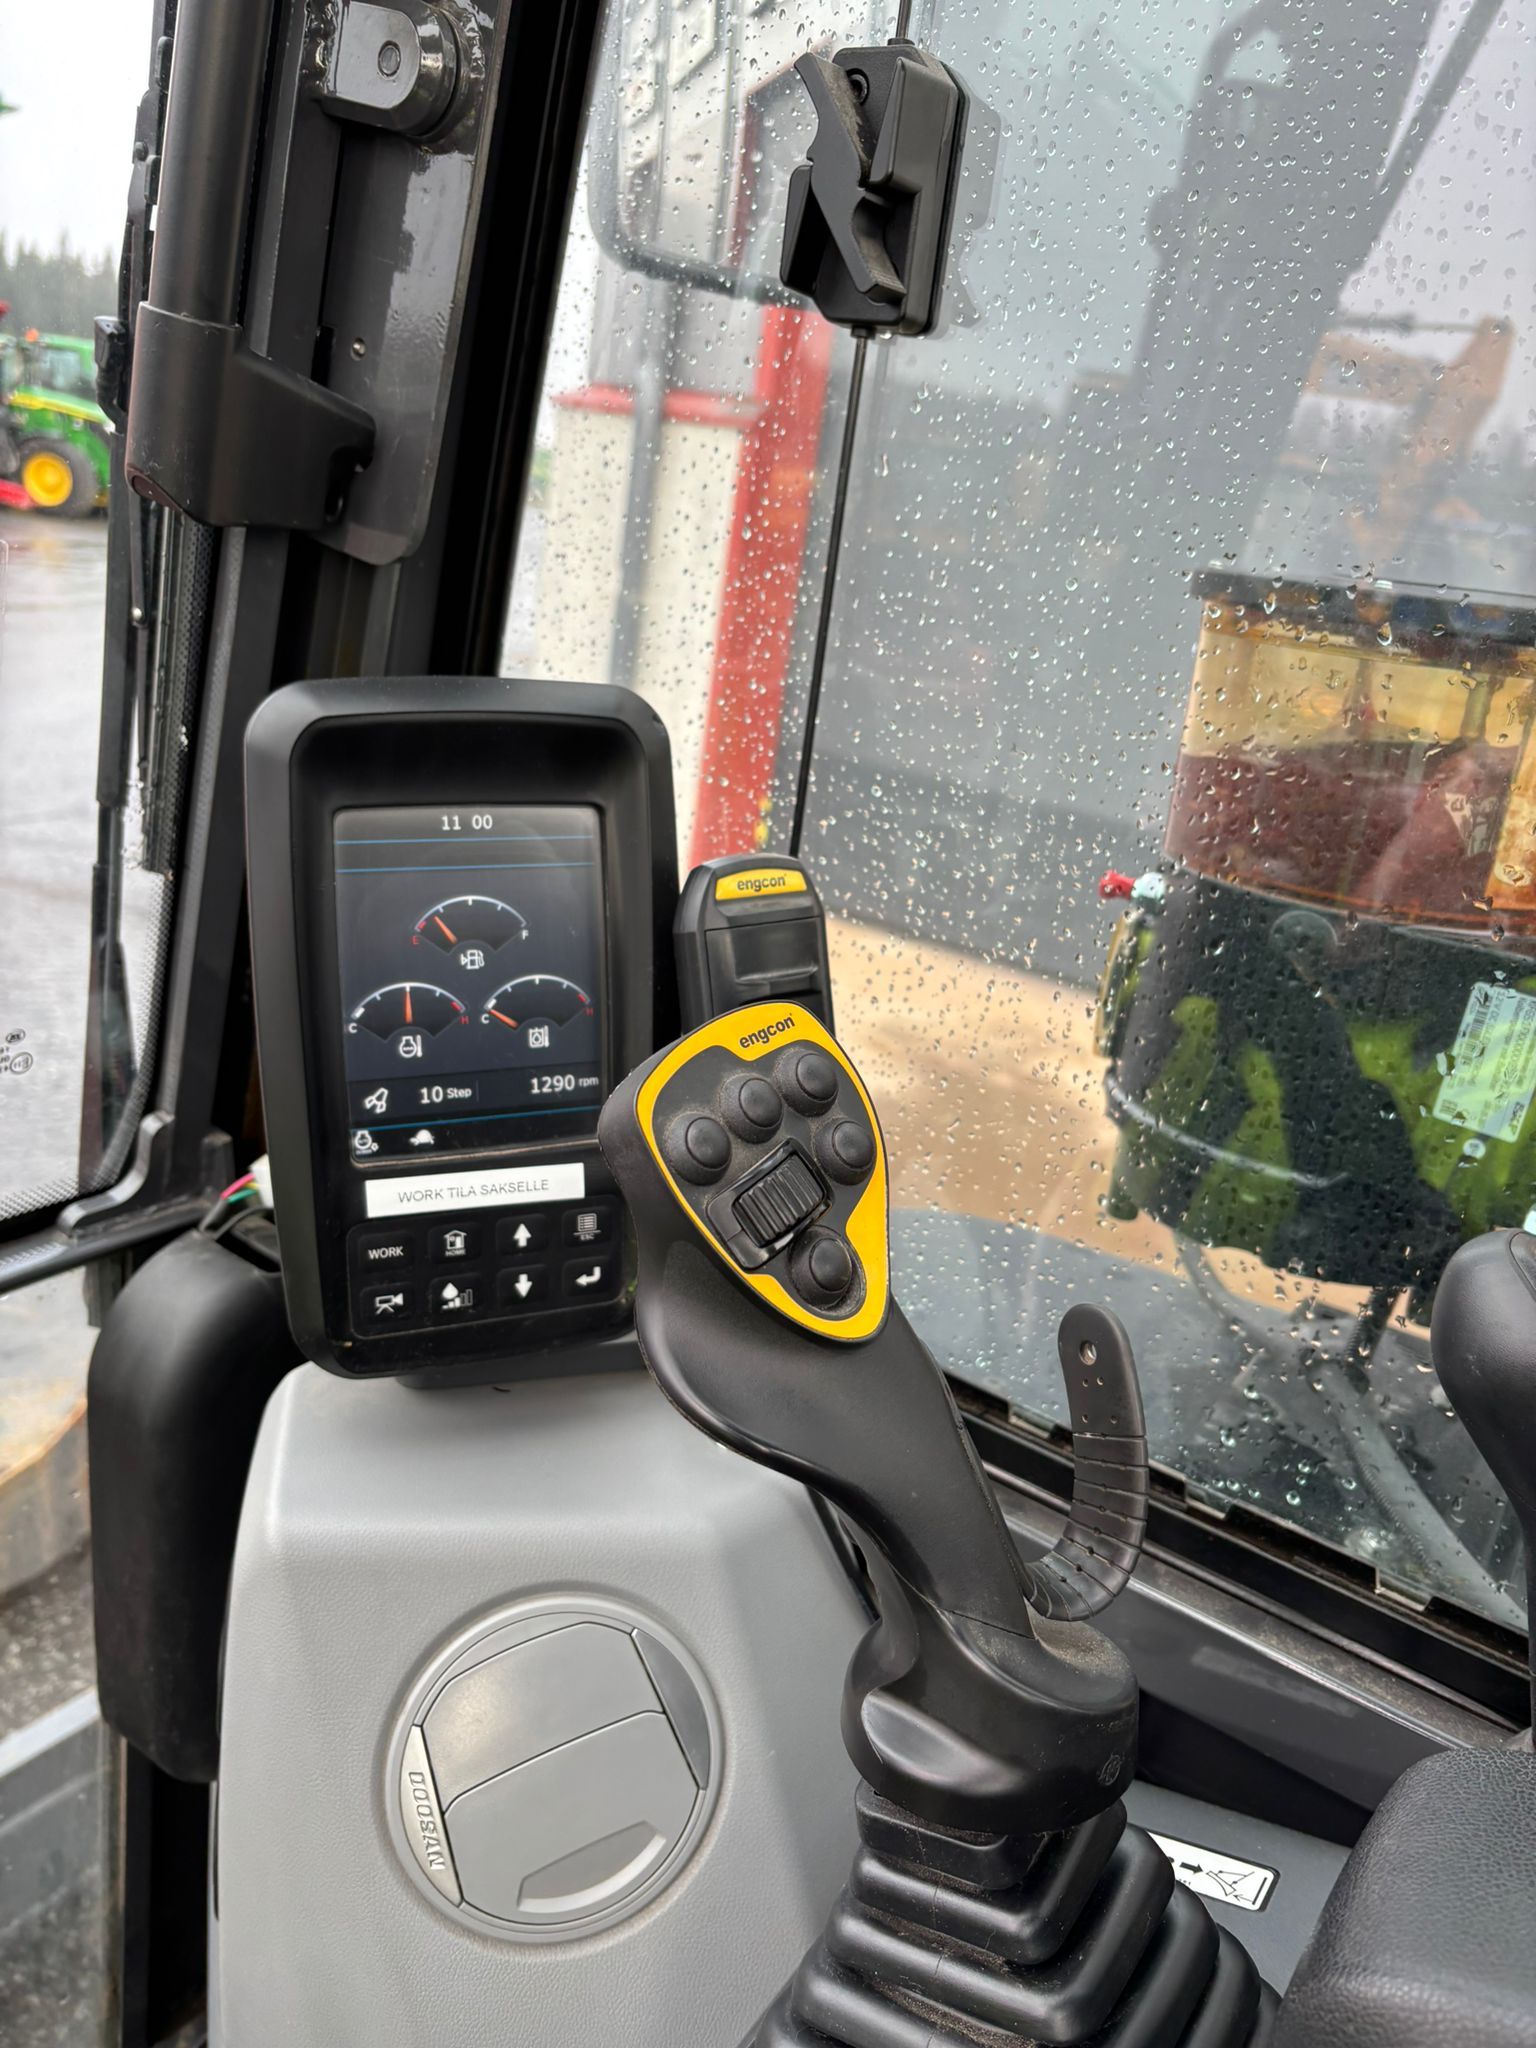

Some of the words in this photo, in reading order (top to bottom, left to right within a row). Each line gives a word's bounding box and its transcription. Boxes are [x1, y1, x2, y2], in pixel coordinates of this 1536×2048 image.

[440, 816, 462, 831] 11
[471, 815, 493, 830] 00
[737, 876, 786, 892] engcon
[411, 935, 420, 945] E
[521, 929, 529, 940] F
[480, 1013, 490, 1024] C
[585, 1006, 594, 1016] H
[460, 1015, 469, 1025] H
[348, 1023, 357, 1033] C
[739, 1017, 795, 1048] engcon
[530, 1074, 575, 1094] 1290
[578, 1076, 599, 1088] rpm
[419, 1086, 444, 1105] 10
[446, 1087, 472, 1100] Step
[398, 1188, 443, 1203] WORK
[447, 1184, 477, 1199] TILA
[480, 1179, 549, 1196] SAKSELLE
[368, 1245, 404, 1260] WORK
[444, 1248, 466, 1257] HOME
[408, 1771, 446, 1871] DOOSAN
